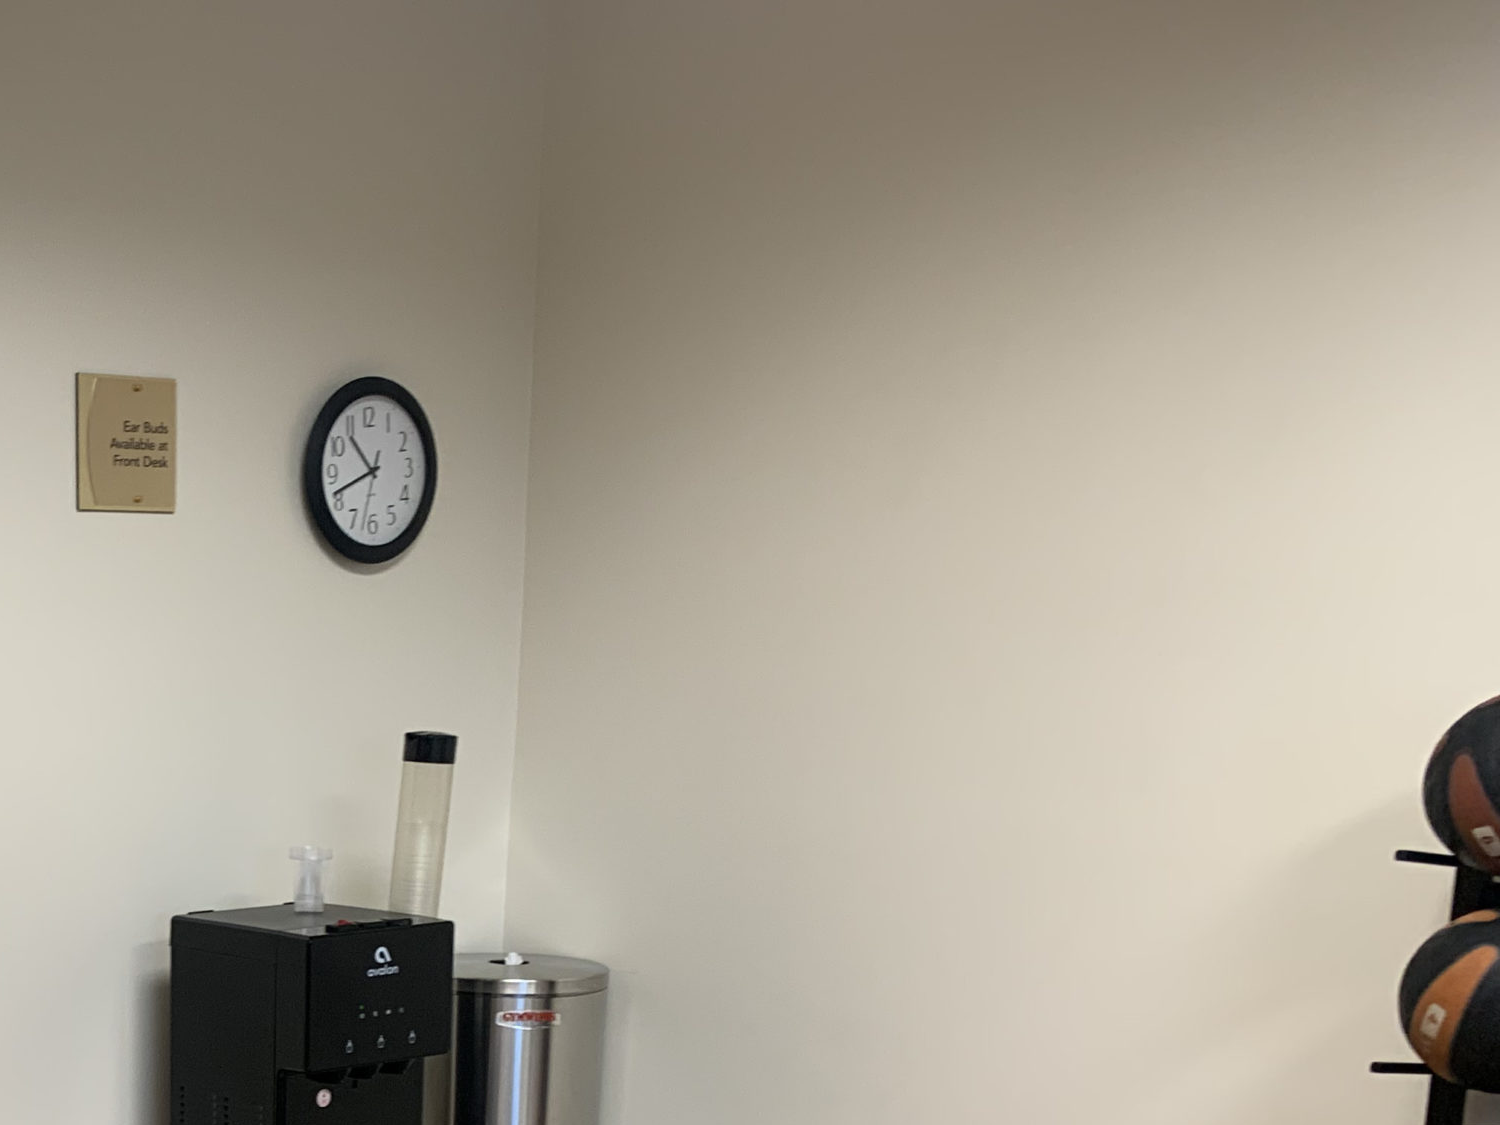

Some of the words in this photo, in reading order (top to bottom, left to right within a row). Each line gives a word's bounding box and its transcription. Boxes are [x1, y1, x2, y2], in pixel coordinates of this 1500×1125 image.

[123, 420, 140, 433] Ear
[143, 421, 169, 434] Buds
[345, 414, 355, 437] 11
[362, 406, 376, 428] 12
[384, 411, 392, 434] 1
[110, 438, 156, 451] Available
[158, 442, 169, 451] at
[331, 435, 345, 457] 10
[398, 430, 408, 453] 2
[112, 454, 140, 467] Front
[143, 455, 169, 468] Desk
[404, 457, 414, 479] 3
[326, 463, 338, 485] 9
[332, 492, 345, 511] 8
[399, 484, 410, 505] 4
[348, 508, 359, 530] 7
[366, 513, 378, 535] 6
[386, 504, 397, 526] 5
